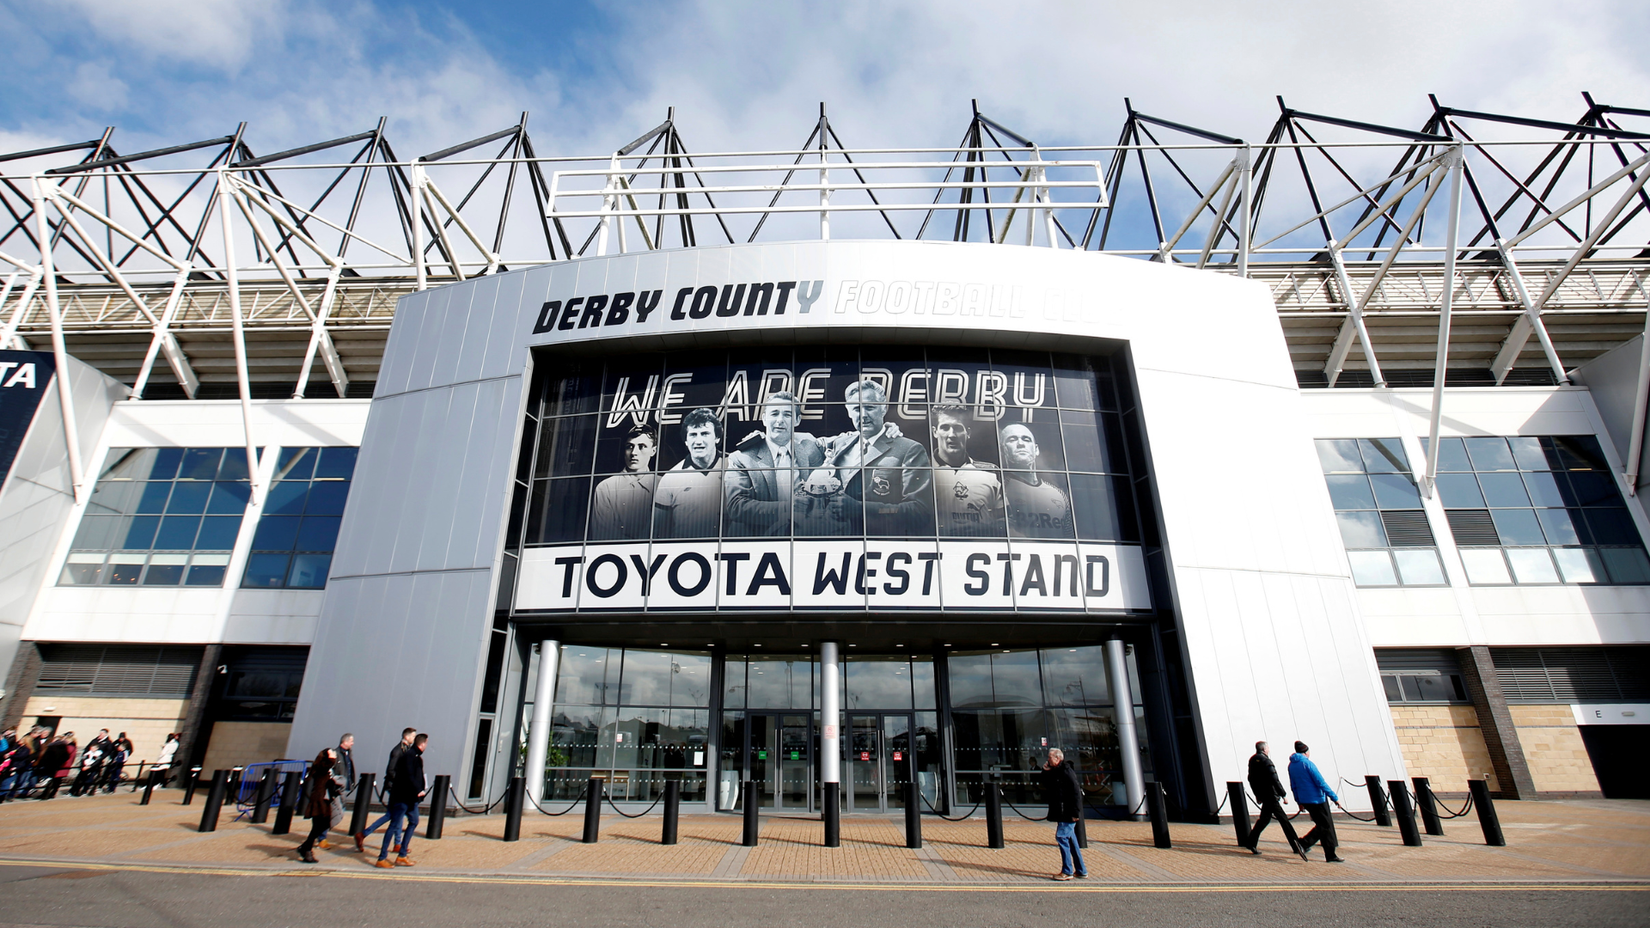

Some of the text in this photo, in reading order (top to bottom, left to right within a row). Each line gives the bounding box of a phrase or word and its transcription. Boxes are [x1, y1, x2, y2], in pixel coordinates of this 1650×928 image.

[532, 289, 662, 334] DERBY
[671, 280, 823, 319] COUNTY
[834, 279, 1026, 319] FOOTBALL
[606, 368, 1046, 429] WE ARE DERBY
[554, 552, 1110, 597] TOYOTA WEST STAND
[1595, 710, 1602, 718] E
